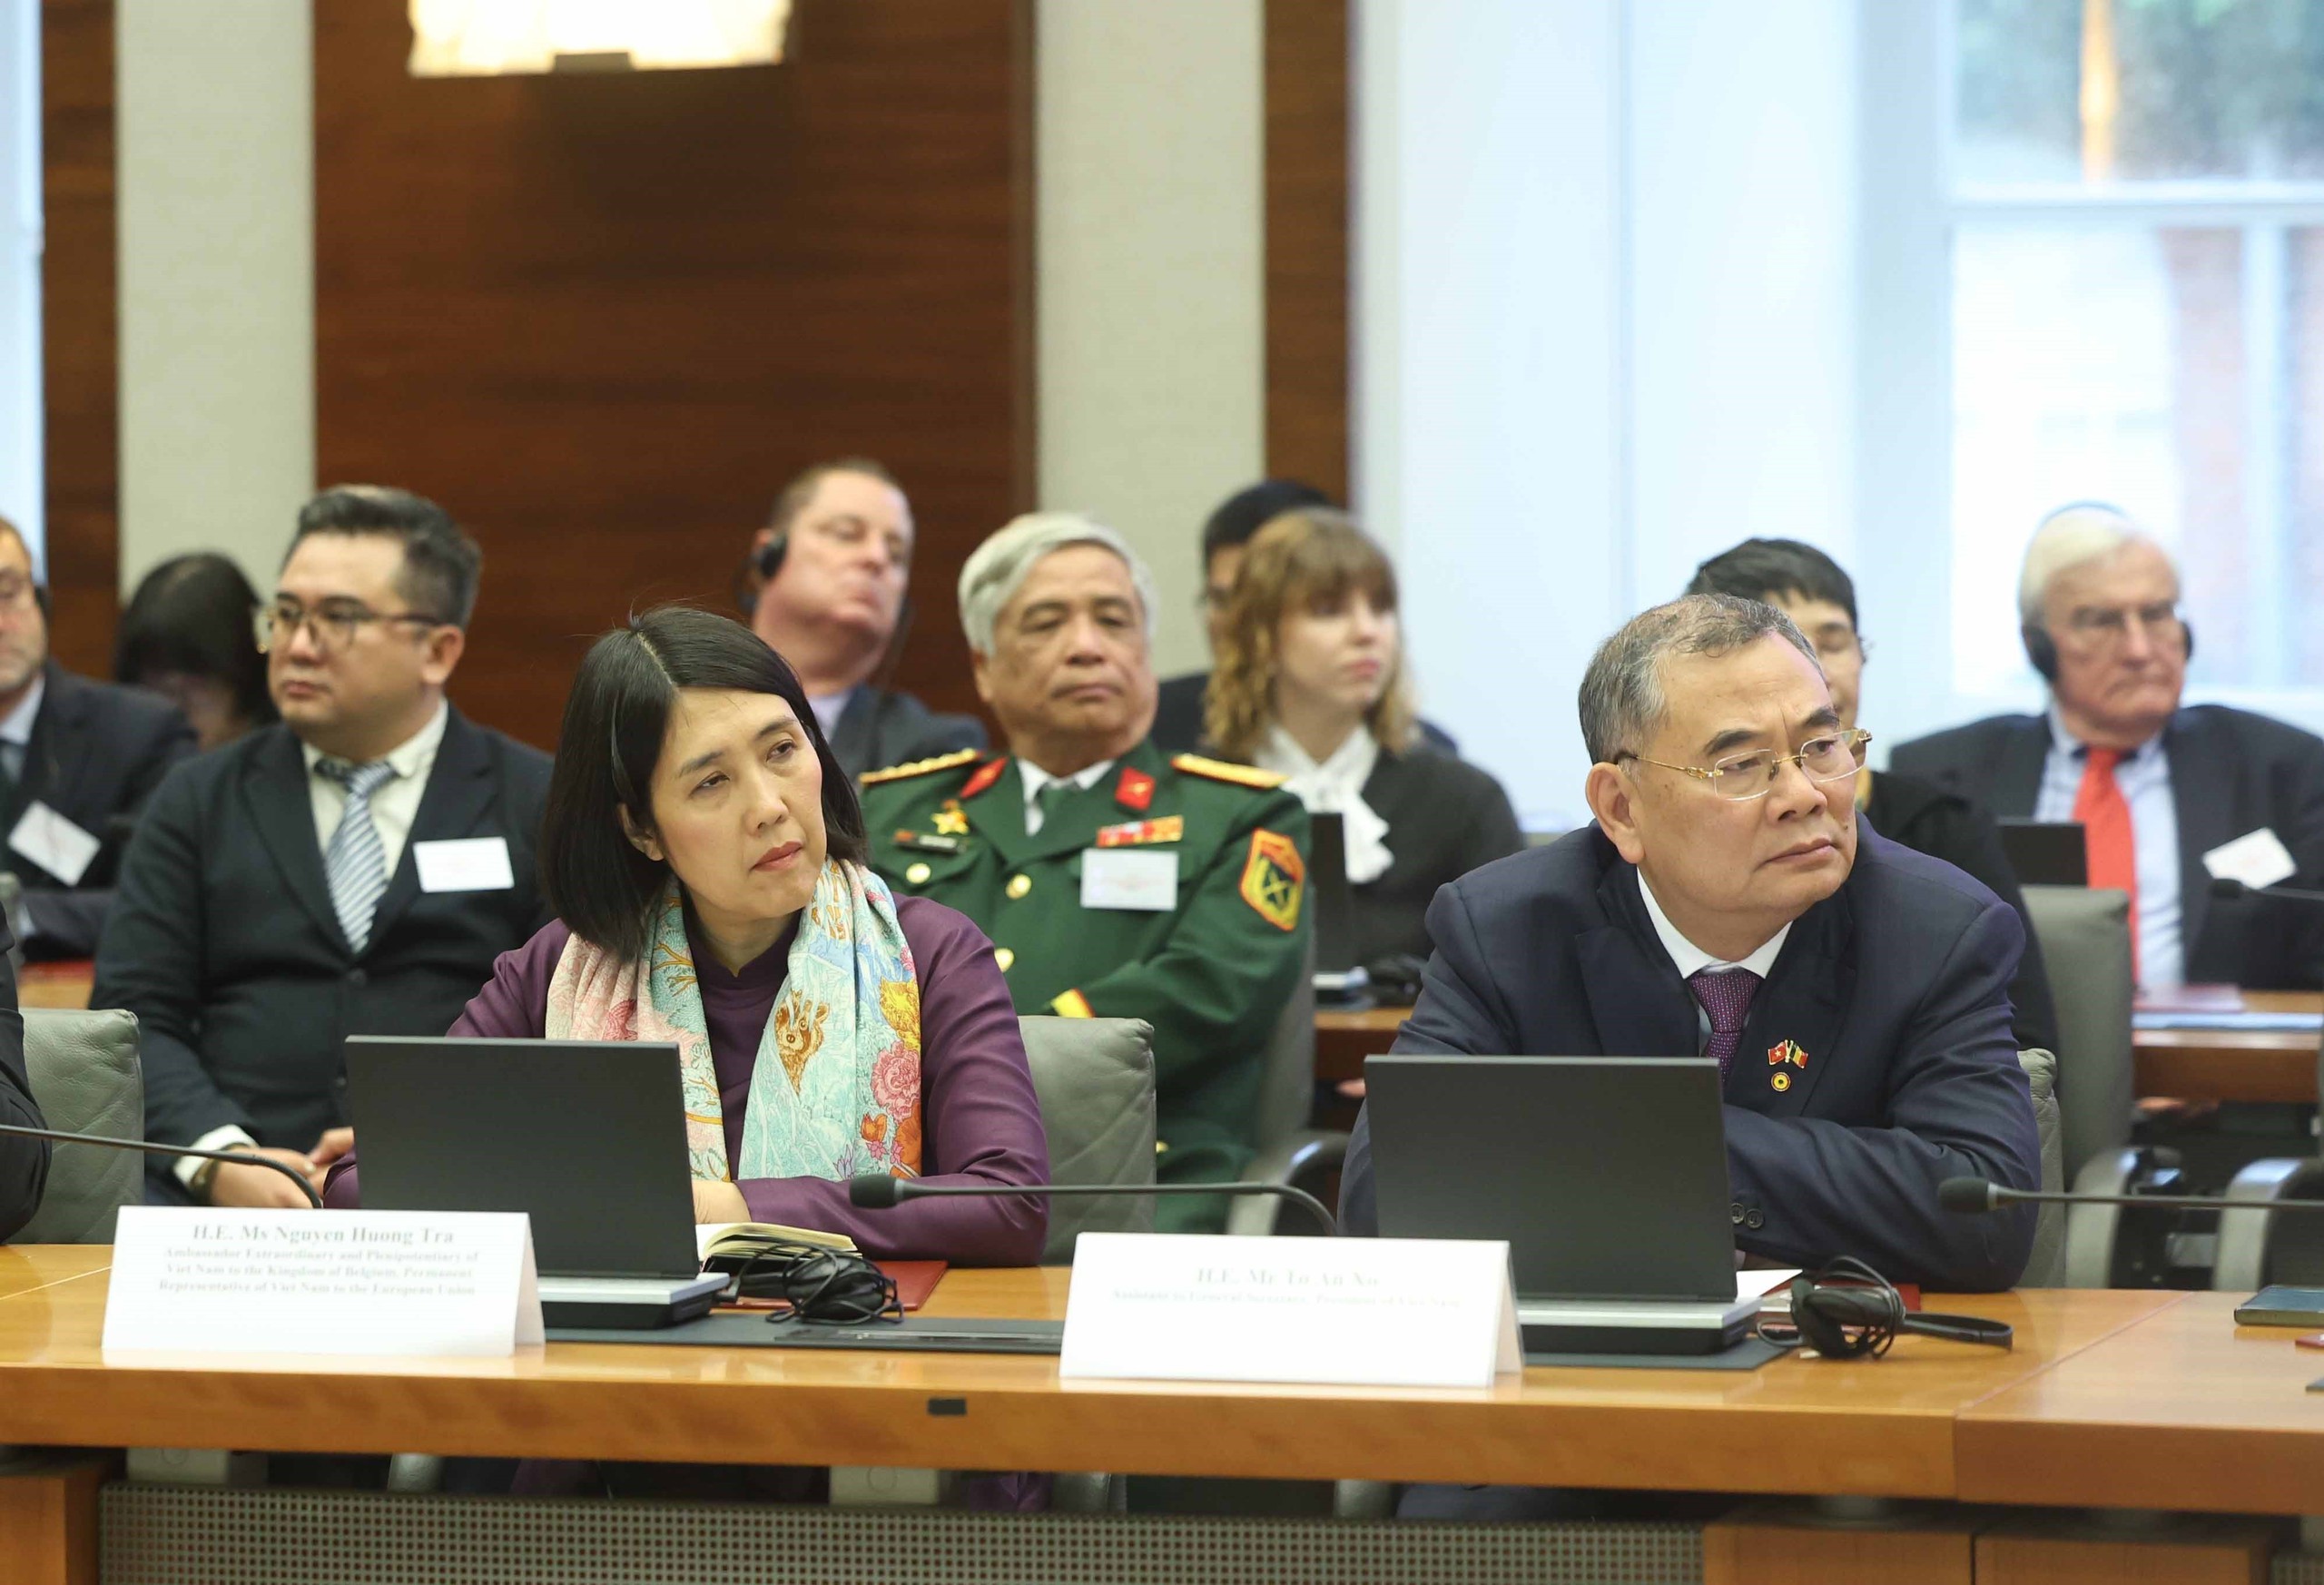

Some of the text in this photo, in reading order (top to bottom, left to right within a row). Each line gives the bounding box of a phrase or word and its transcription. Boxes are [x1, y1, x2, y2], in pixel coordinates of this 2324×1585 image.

[192, 1224, 455, 1248] H.E. Ms Nguyen Huong Tra
